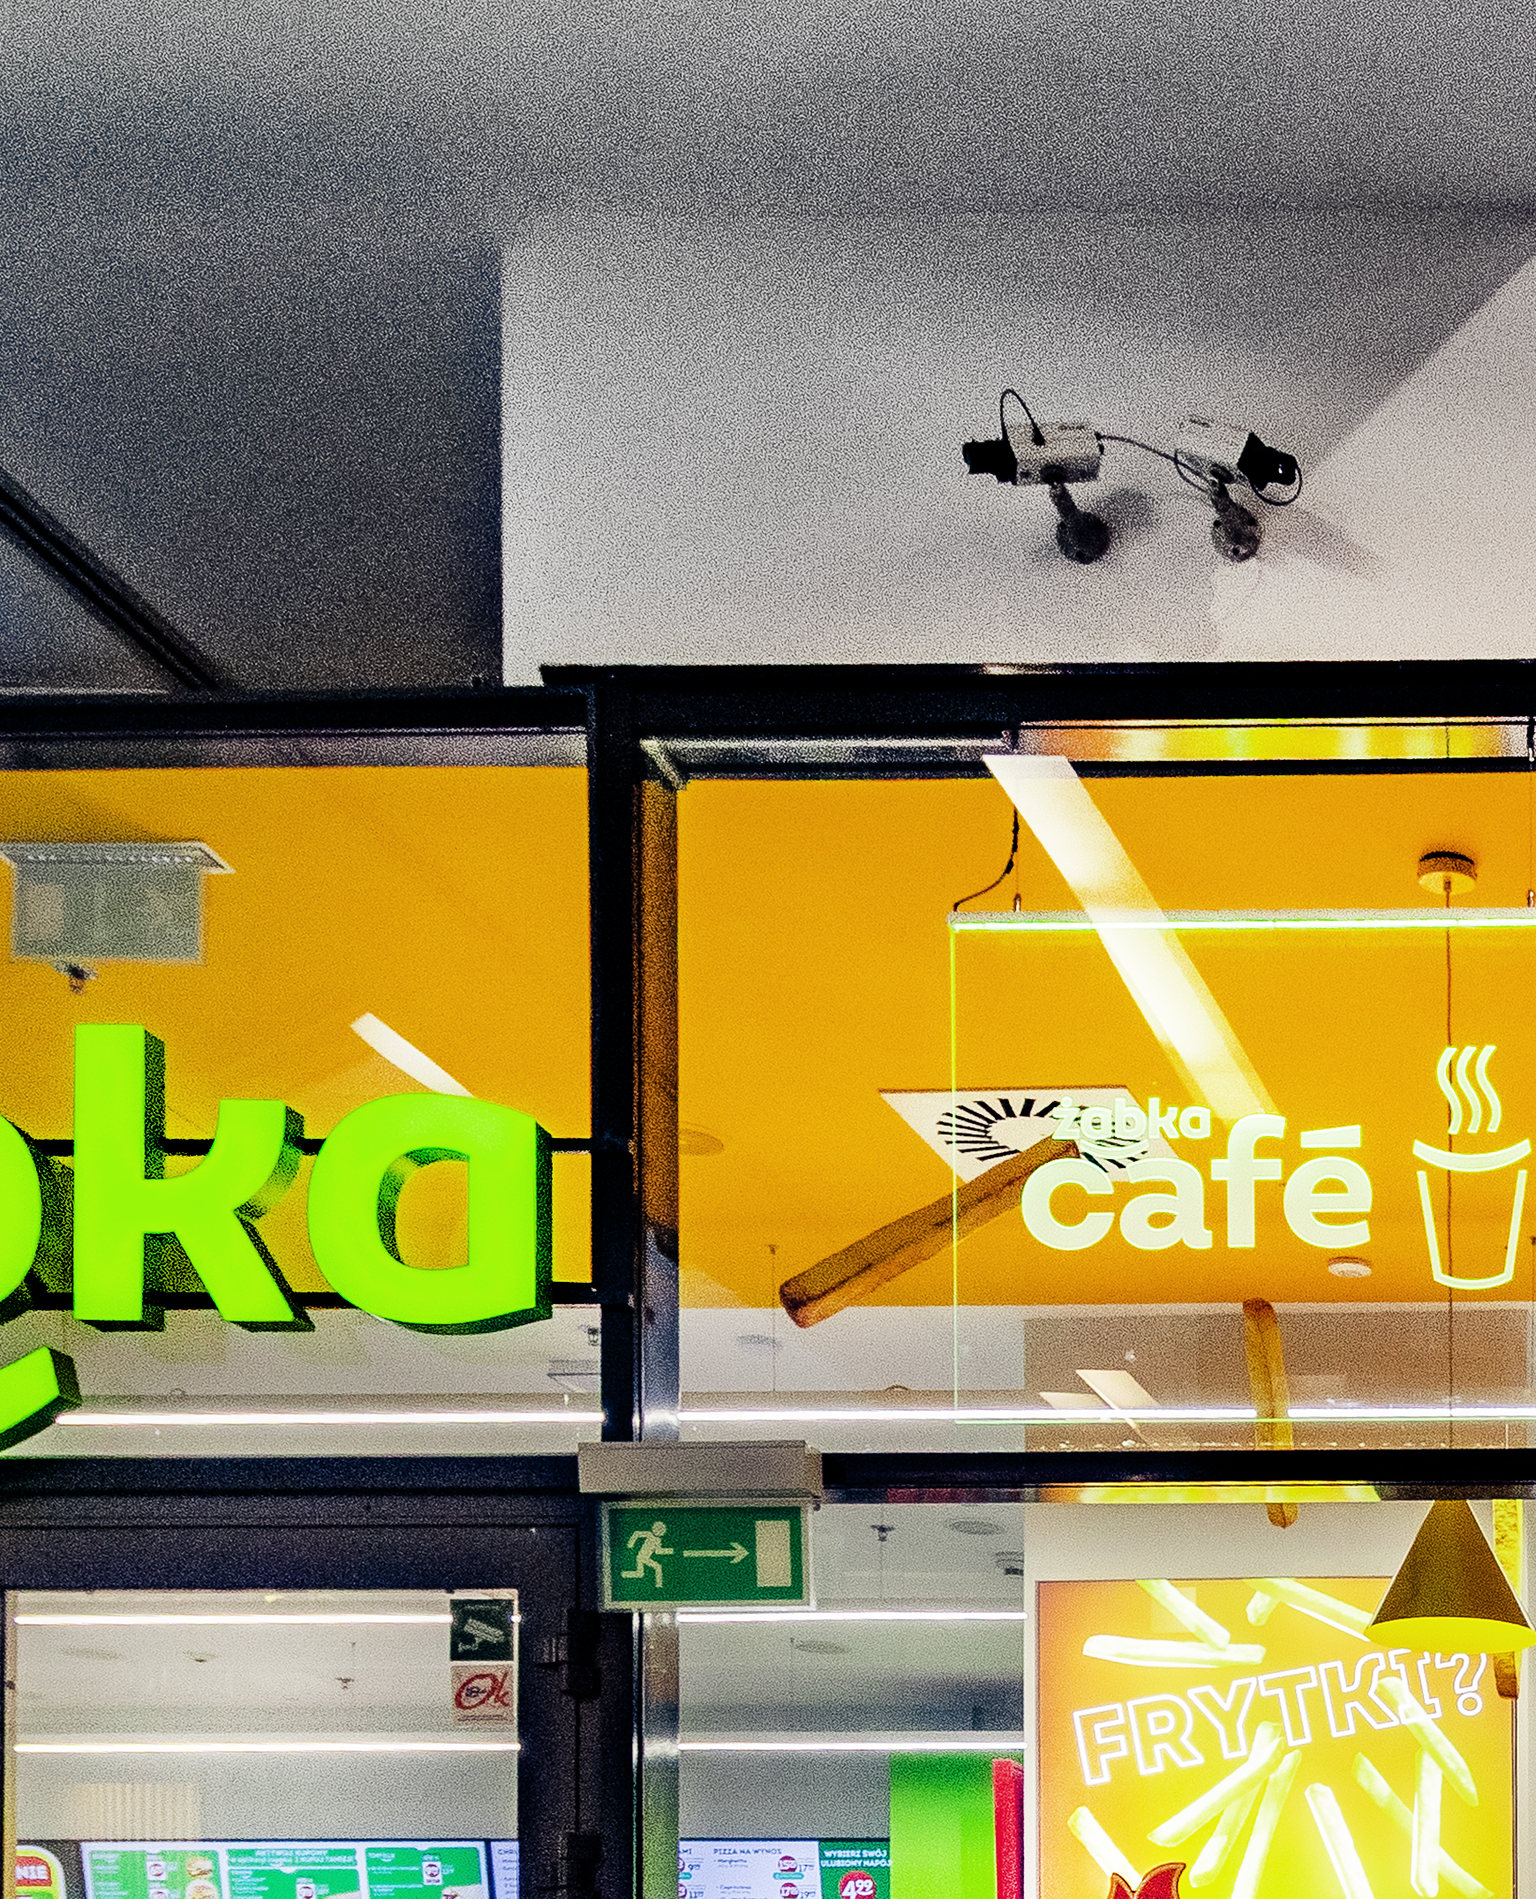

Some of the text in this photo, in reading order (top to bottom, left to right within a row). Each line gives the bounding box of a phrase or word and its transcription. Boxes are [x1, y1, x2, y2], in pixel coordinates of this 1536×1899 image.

[1052, 1096, 1211, 1142] żabka
[1020, 1113, 1374, 1251] café
[1072, 1650, 1487, 1786] FRYTKI?
[821, 1859, 862, 1867] ULUBIONY
[824, 1848, 887, 1858] WYBIERZ SWÓJ
